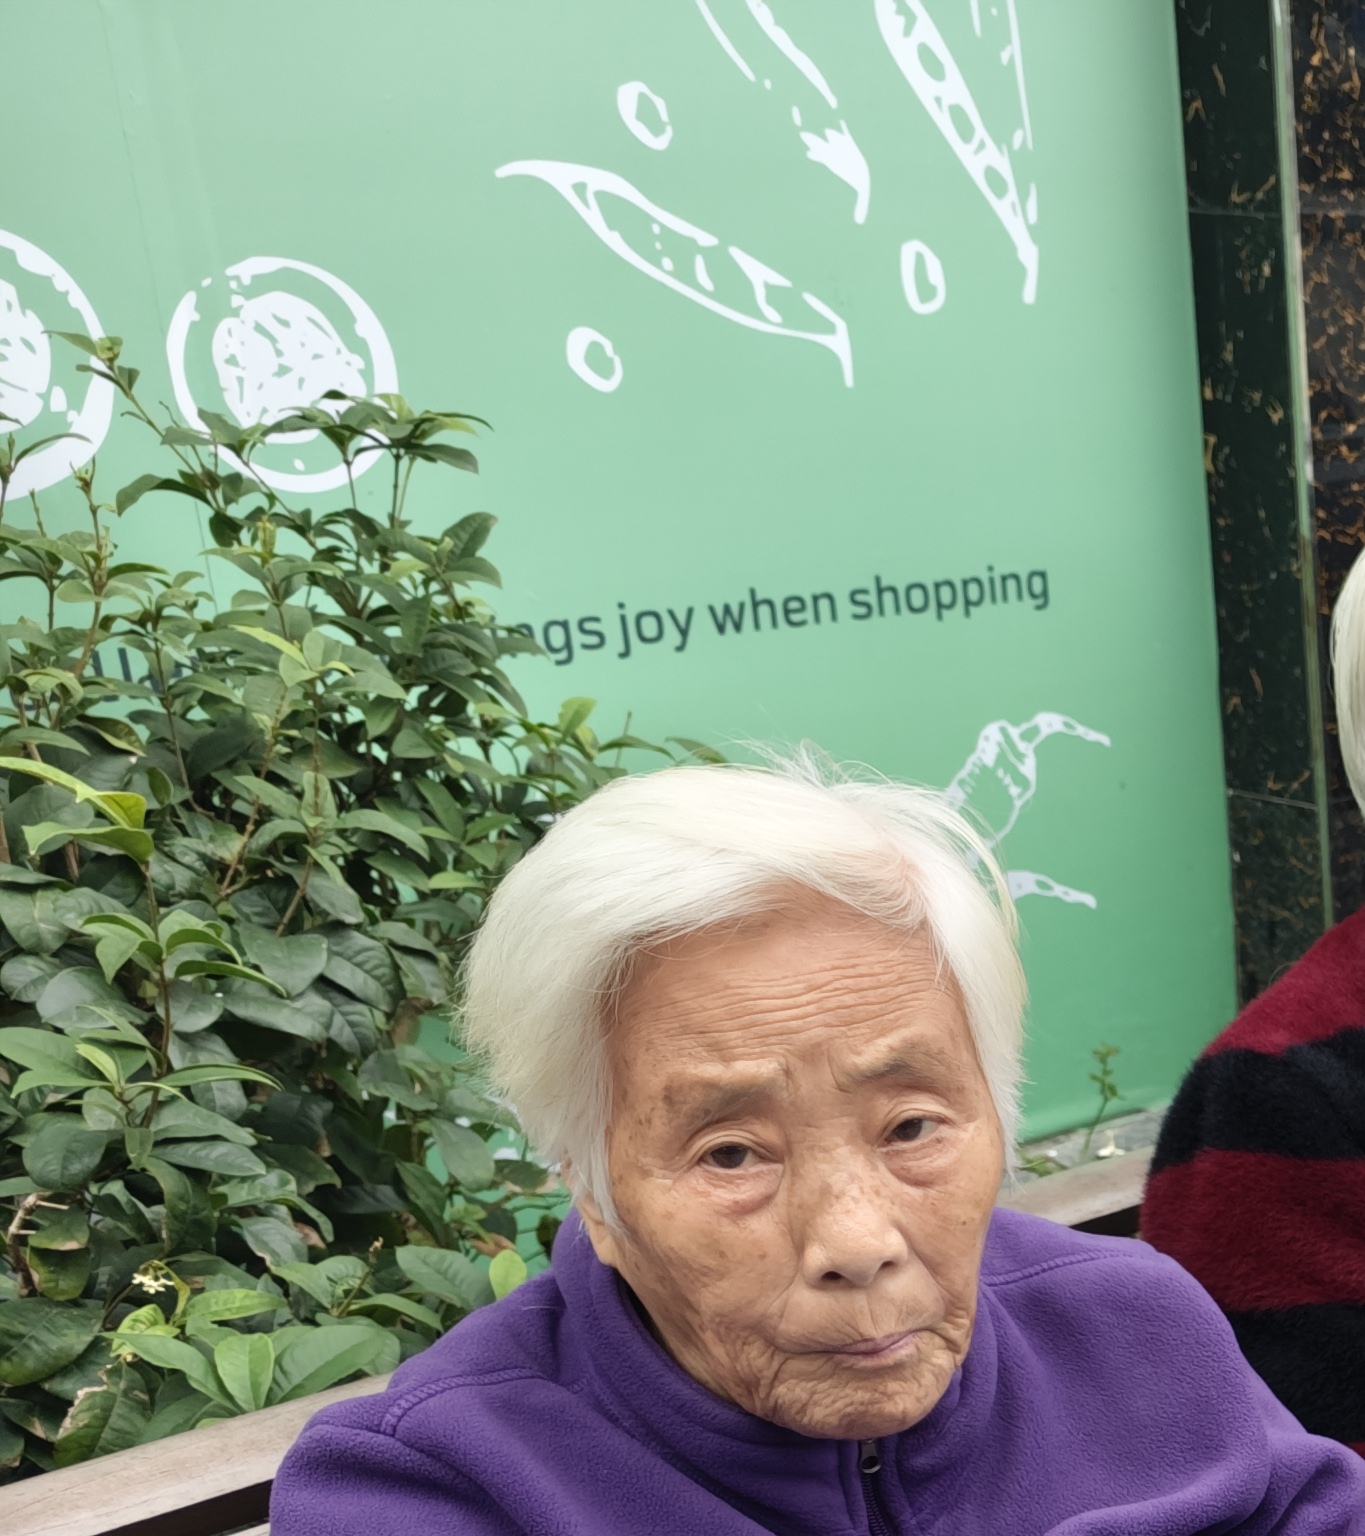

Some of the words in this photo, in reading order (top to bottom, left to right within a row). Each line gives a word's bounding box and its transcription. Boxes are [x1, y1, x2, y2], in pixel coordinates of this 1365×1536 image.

[616, 601, 694, 659] joy
[708, 587, 837, 636] when
[849, 564, 1050, 621] shopping
